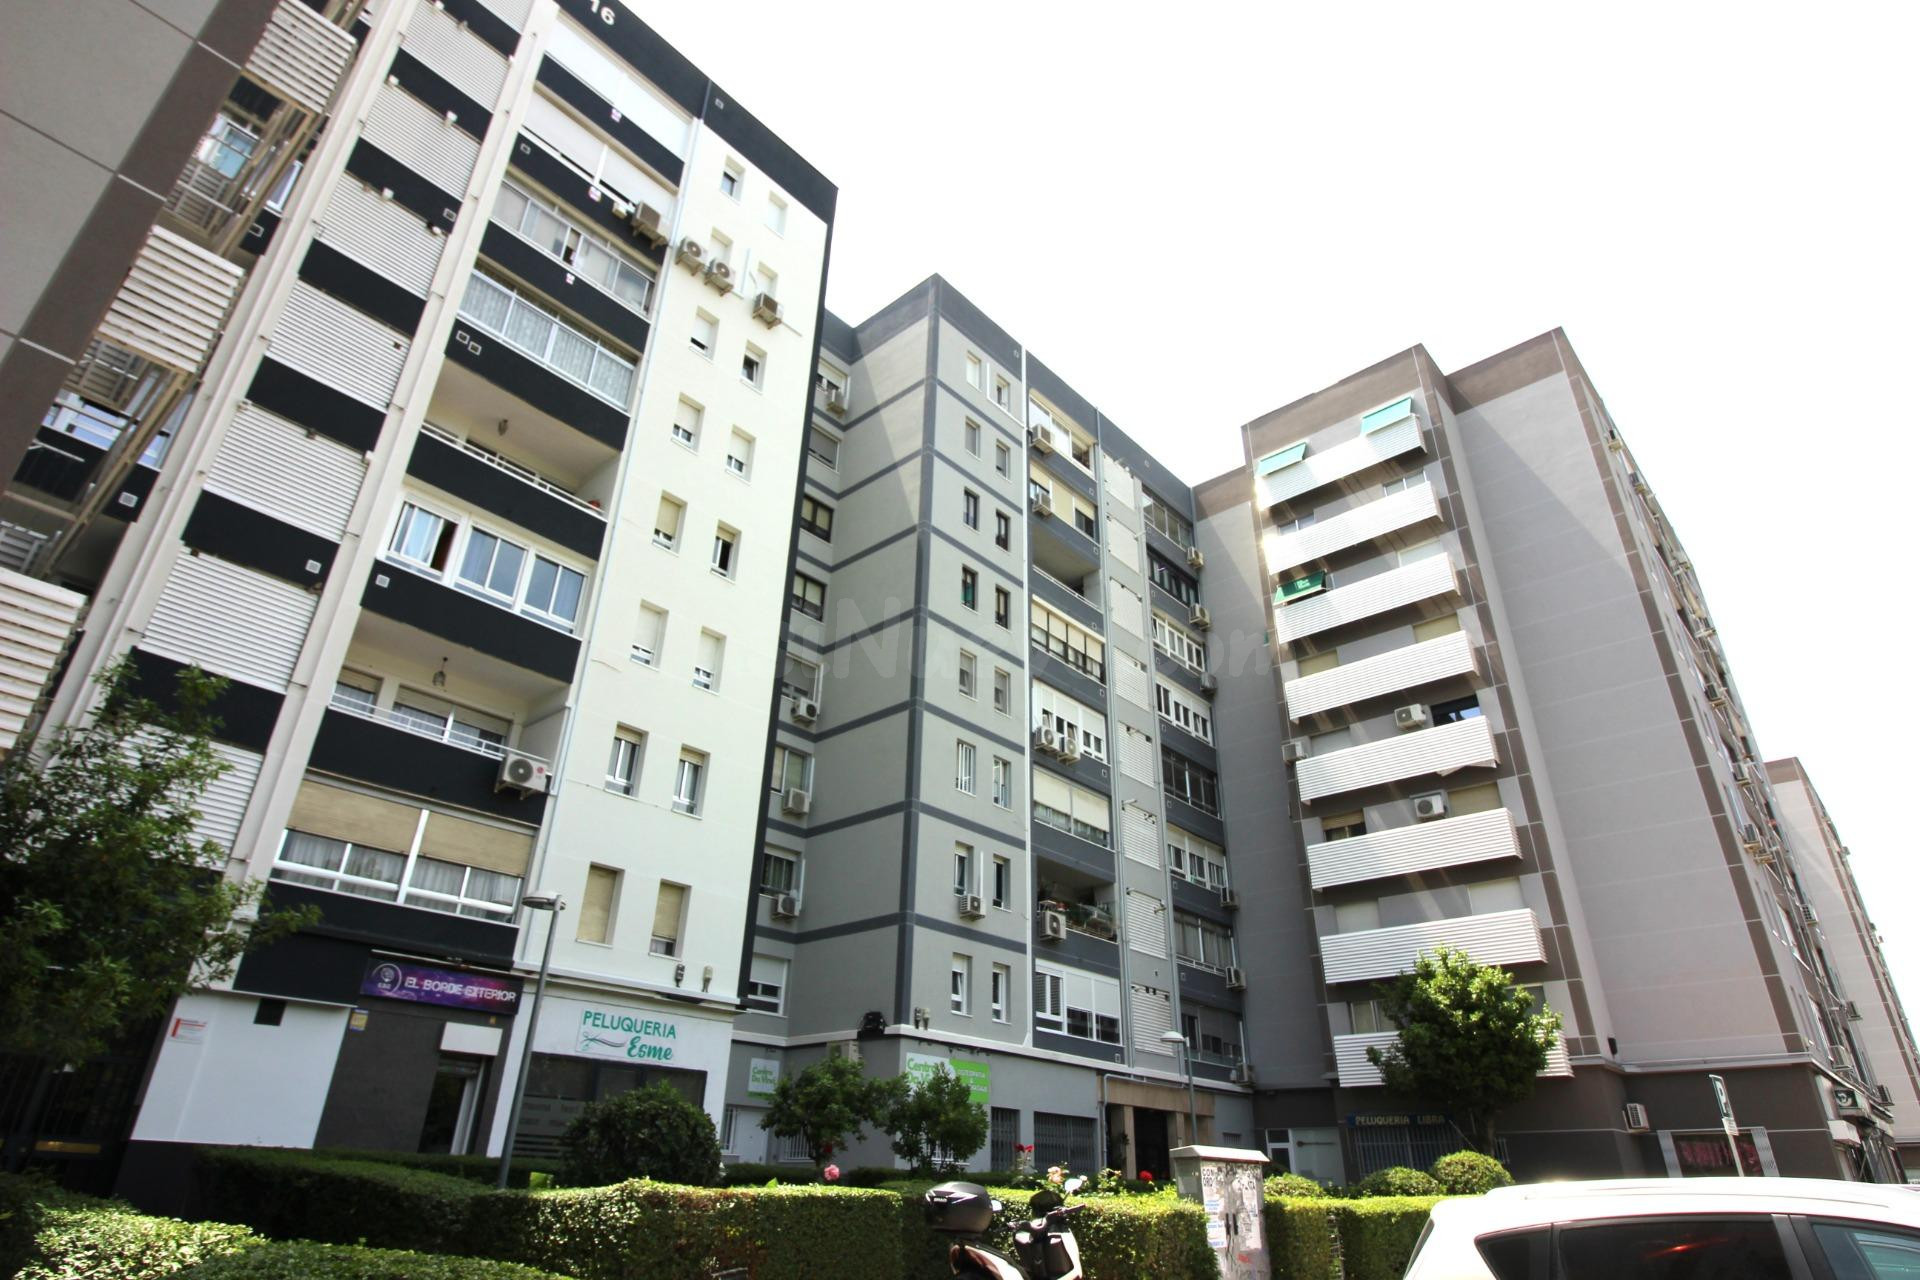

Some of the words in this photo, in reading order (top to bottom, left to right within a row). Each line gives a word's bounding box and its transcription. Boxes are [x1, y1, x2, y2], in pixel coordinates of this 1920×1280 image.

[404, 976, 420, 989] EL
[422, 979, 463, 995] BORDE
[464, 985, 517, 1002] EXTERIOR
[583, 1010, 677, 1040] PELUQUERIA
[627, 1035, 673, 1061] Esme
[1714, 1080, 1727, 1114] P
